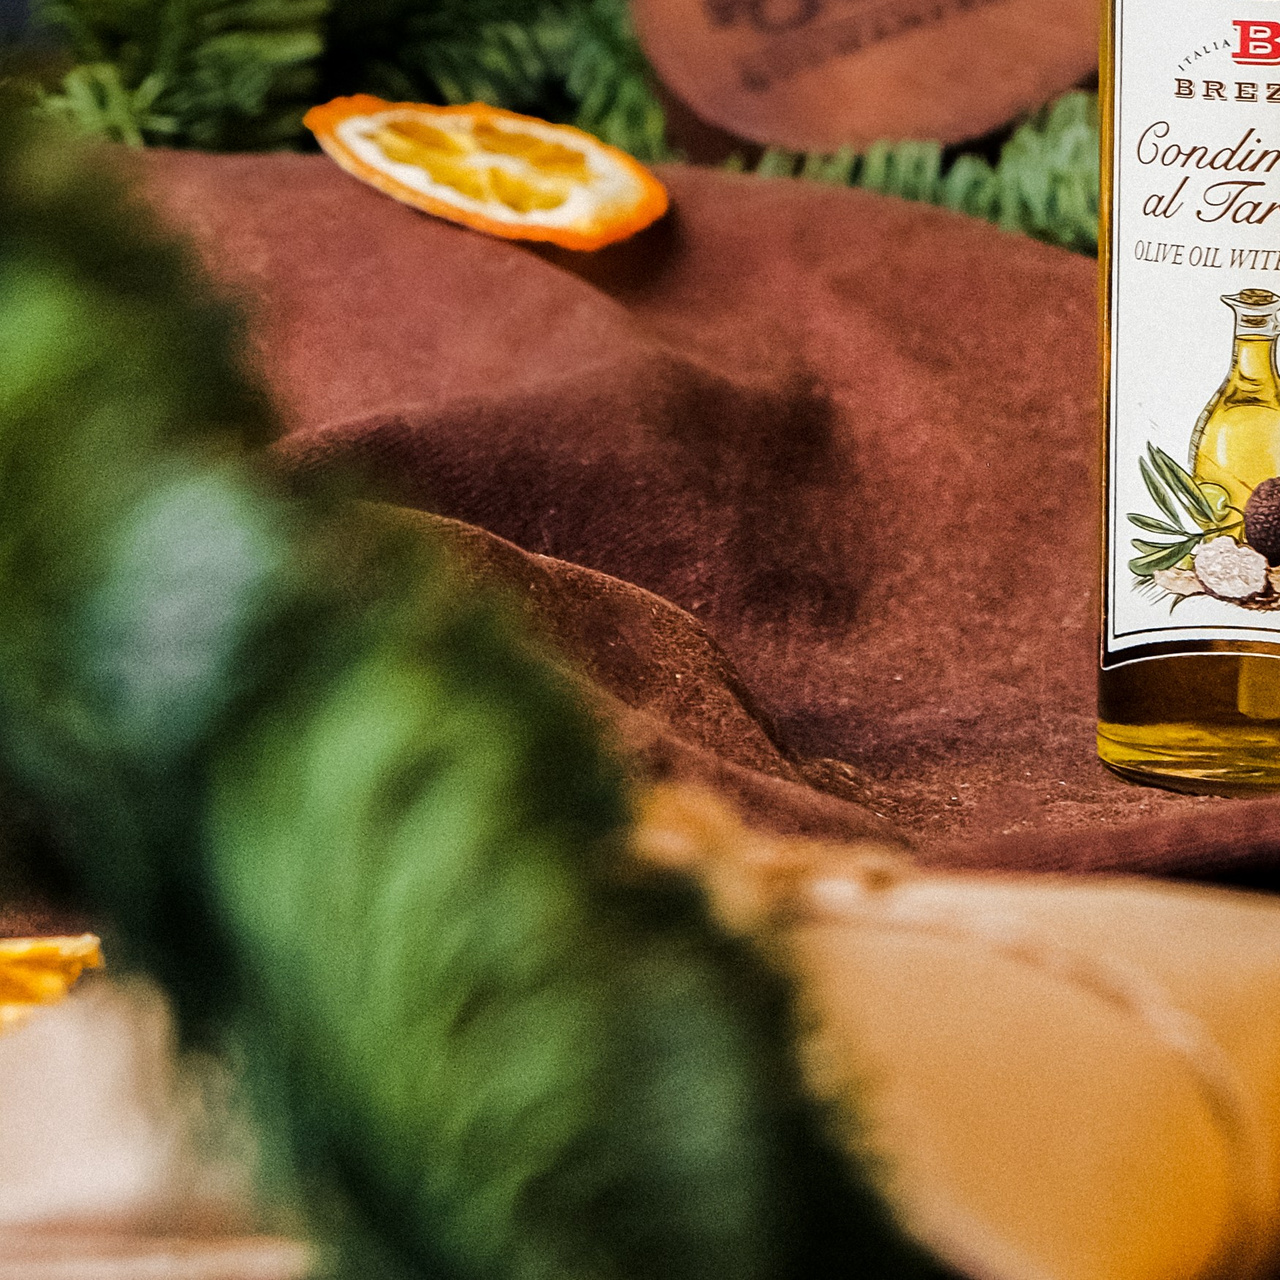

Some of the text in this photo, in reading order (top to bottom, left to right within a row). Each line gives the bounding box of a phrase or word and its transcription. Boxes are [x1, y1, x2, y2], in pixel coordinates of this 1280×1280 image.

[1178, 39, 1231, 71] ITALIA
[1142, 175, 1191, 219] al
[1134, 239, 1185, 266] OLIVE
[1188, 245, 1223, 269] OIL
